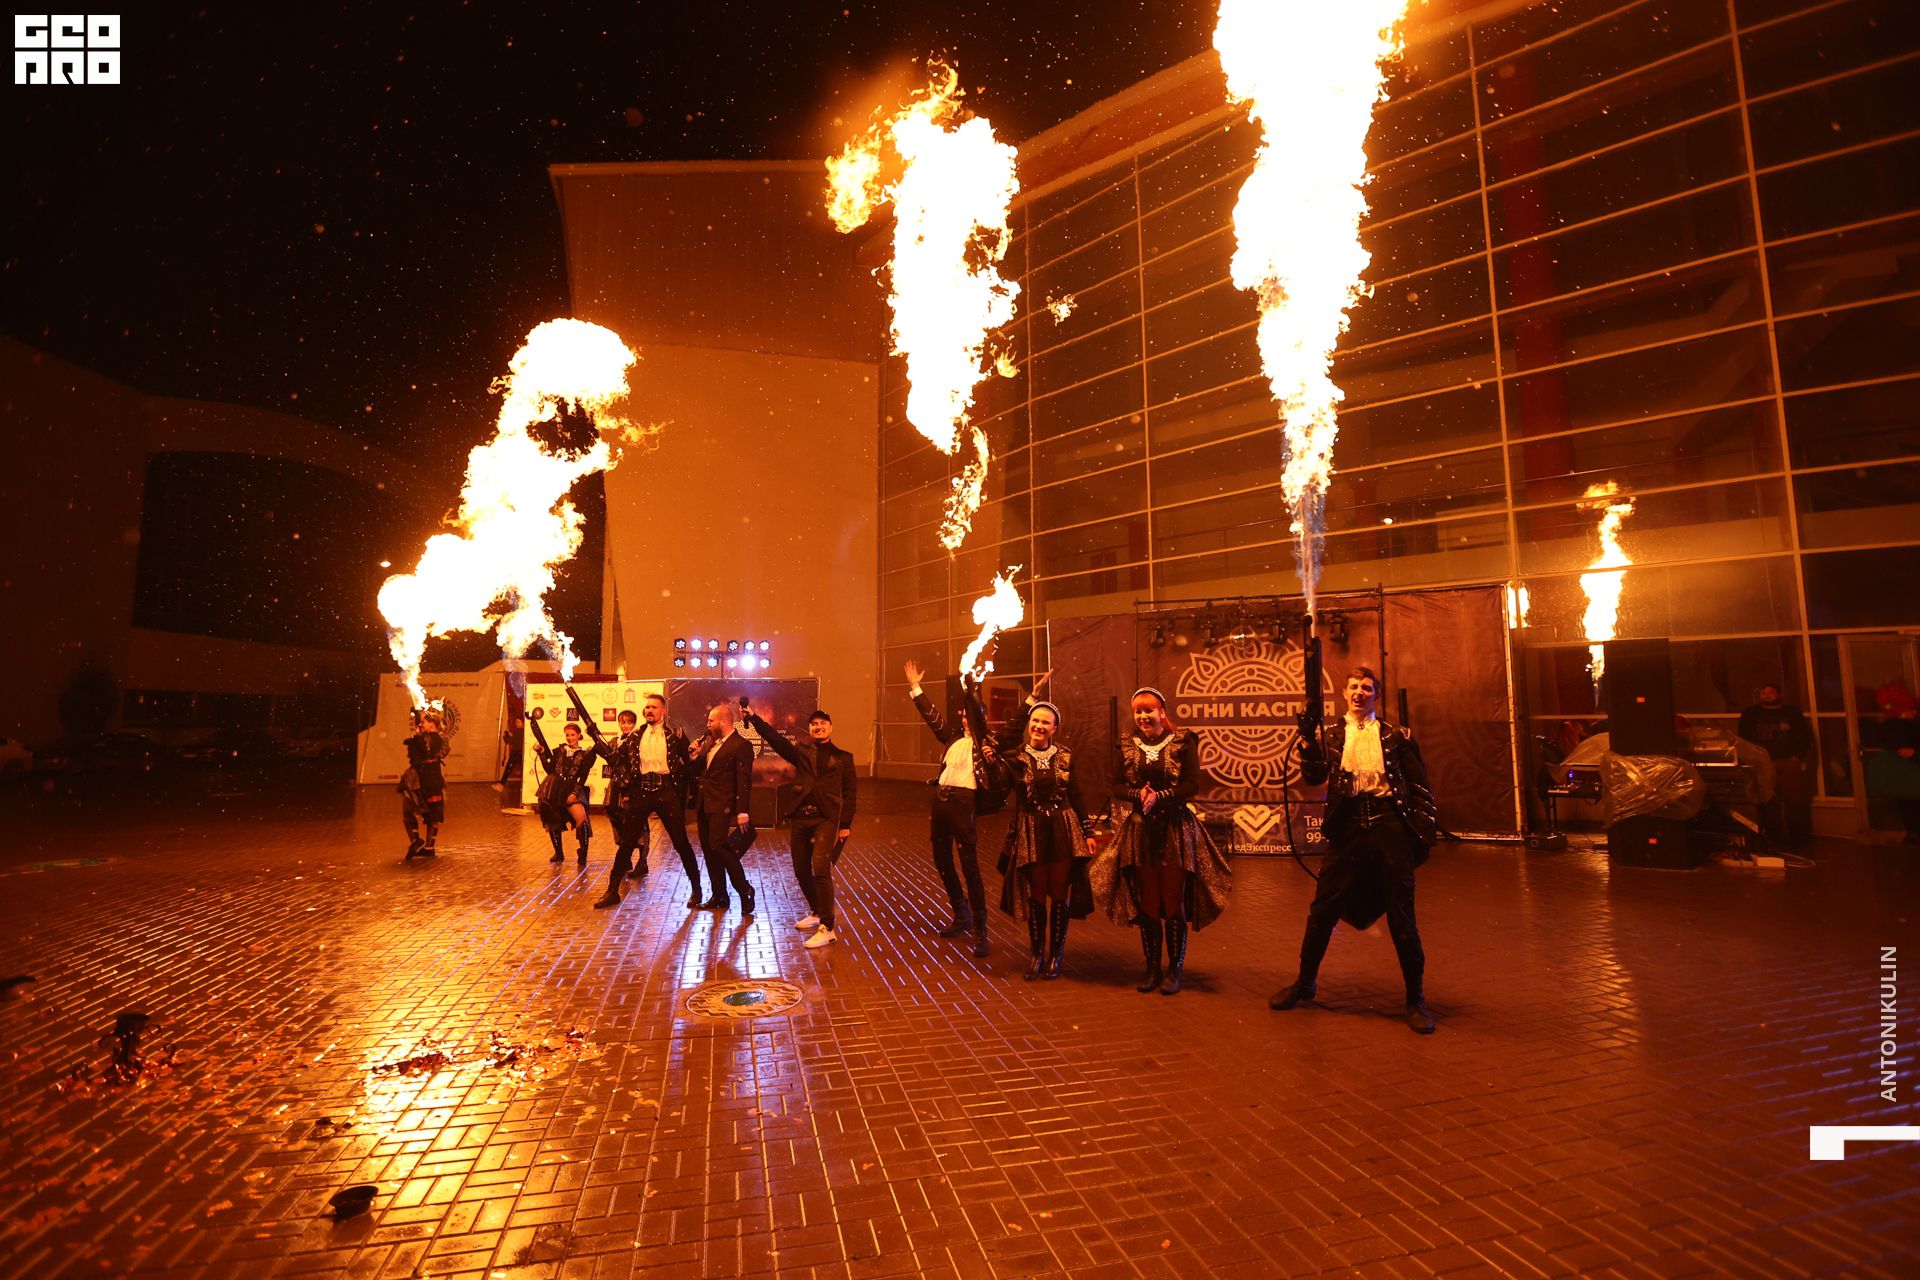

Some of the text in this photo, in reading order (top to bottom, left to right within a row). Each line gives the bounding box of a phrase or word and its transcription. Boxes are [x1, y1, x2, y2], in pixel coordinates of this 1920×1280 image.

[1176, 701, 1335, 718] ОГНИ КАСПЯ
[1303, 815, 1324, 827] Так
[1305, 832, 1326, 843] 99-
